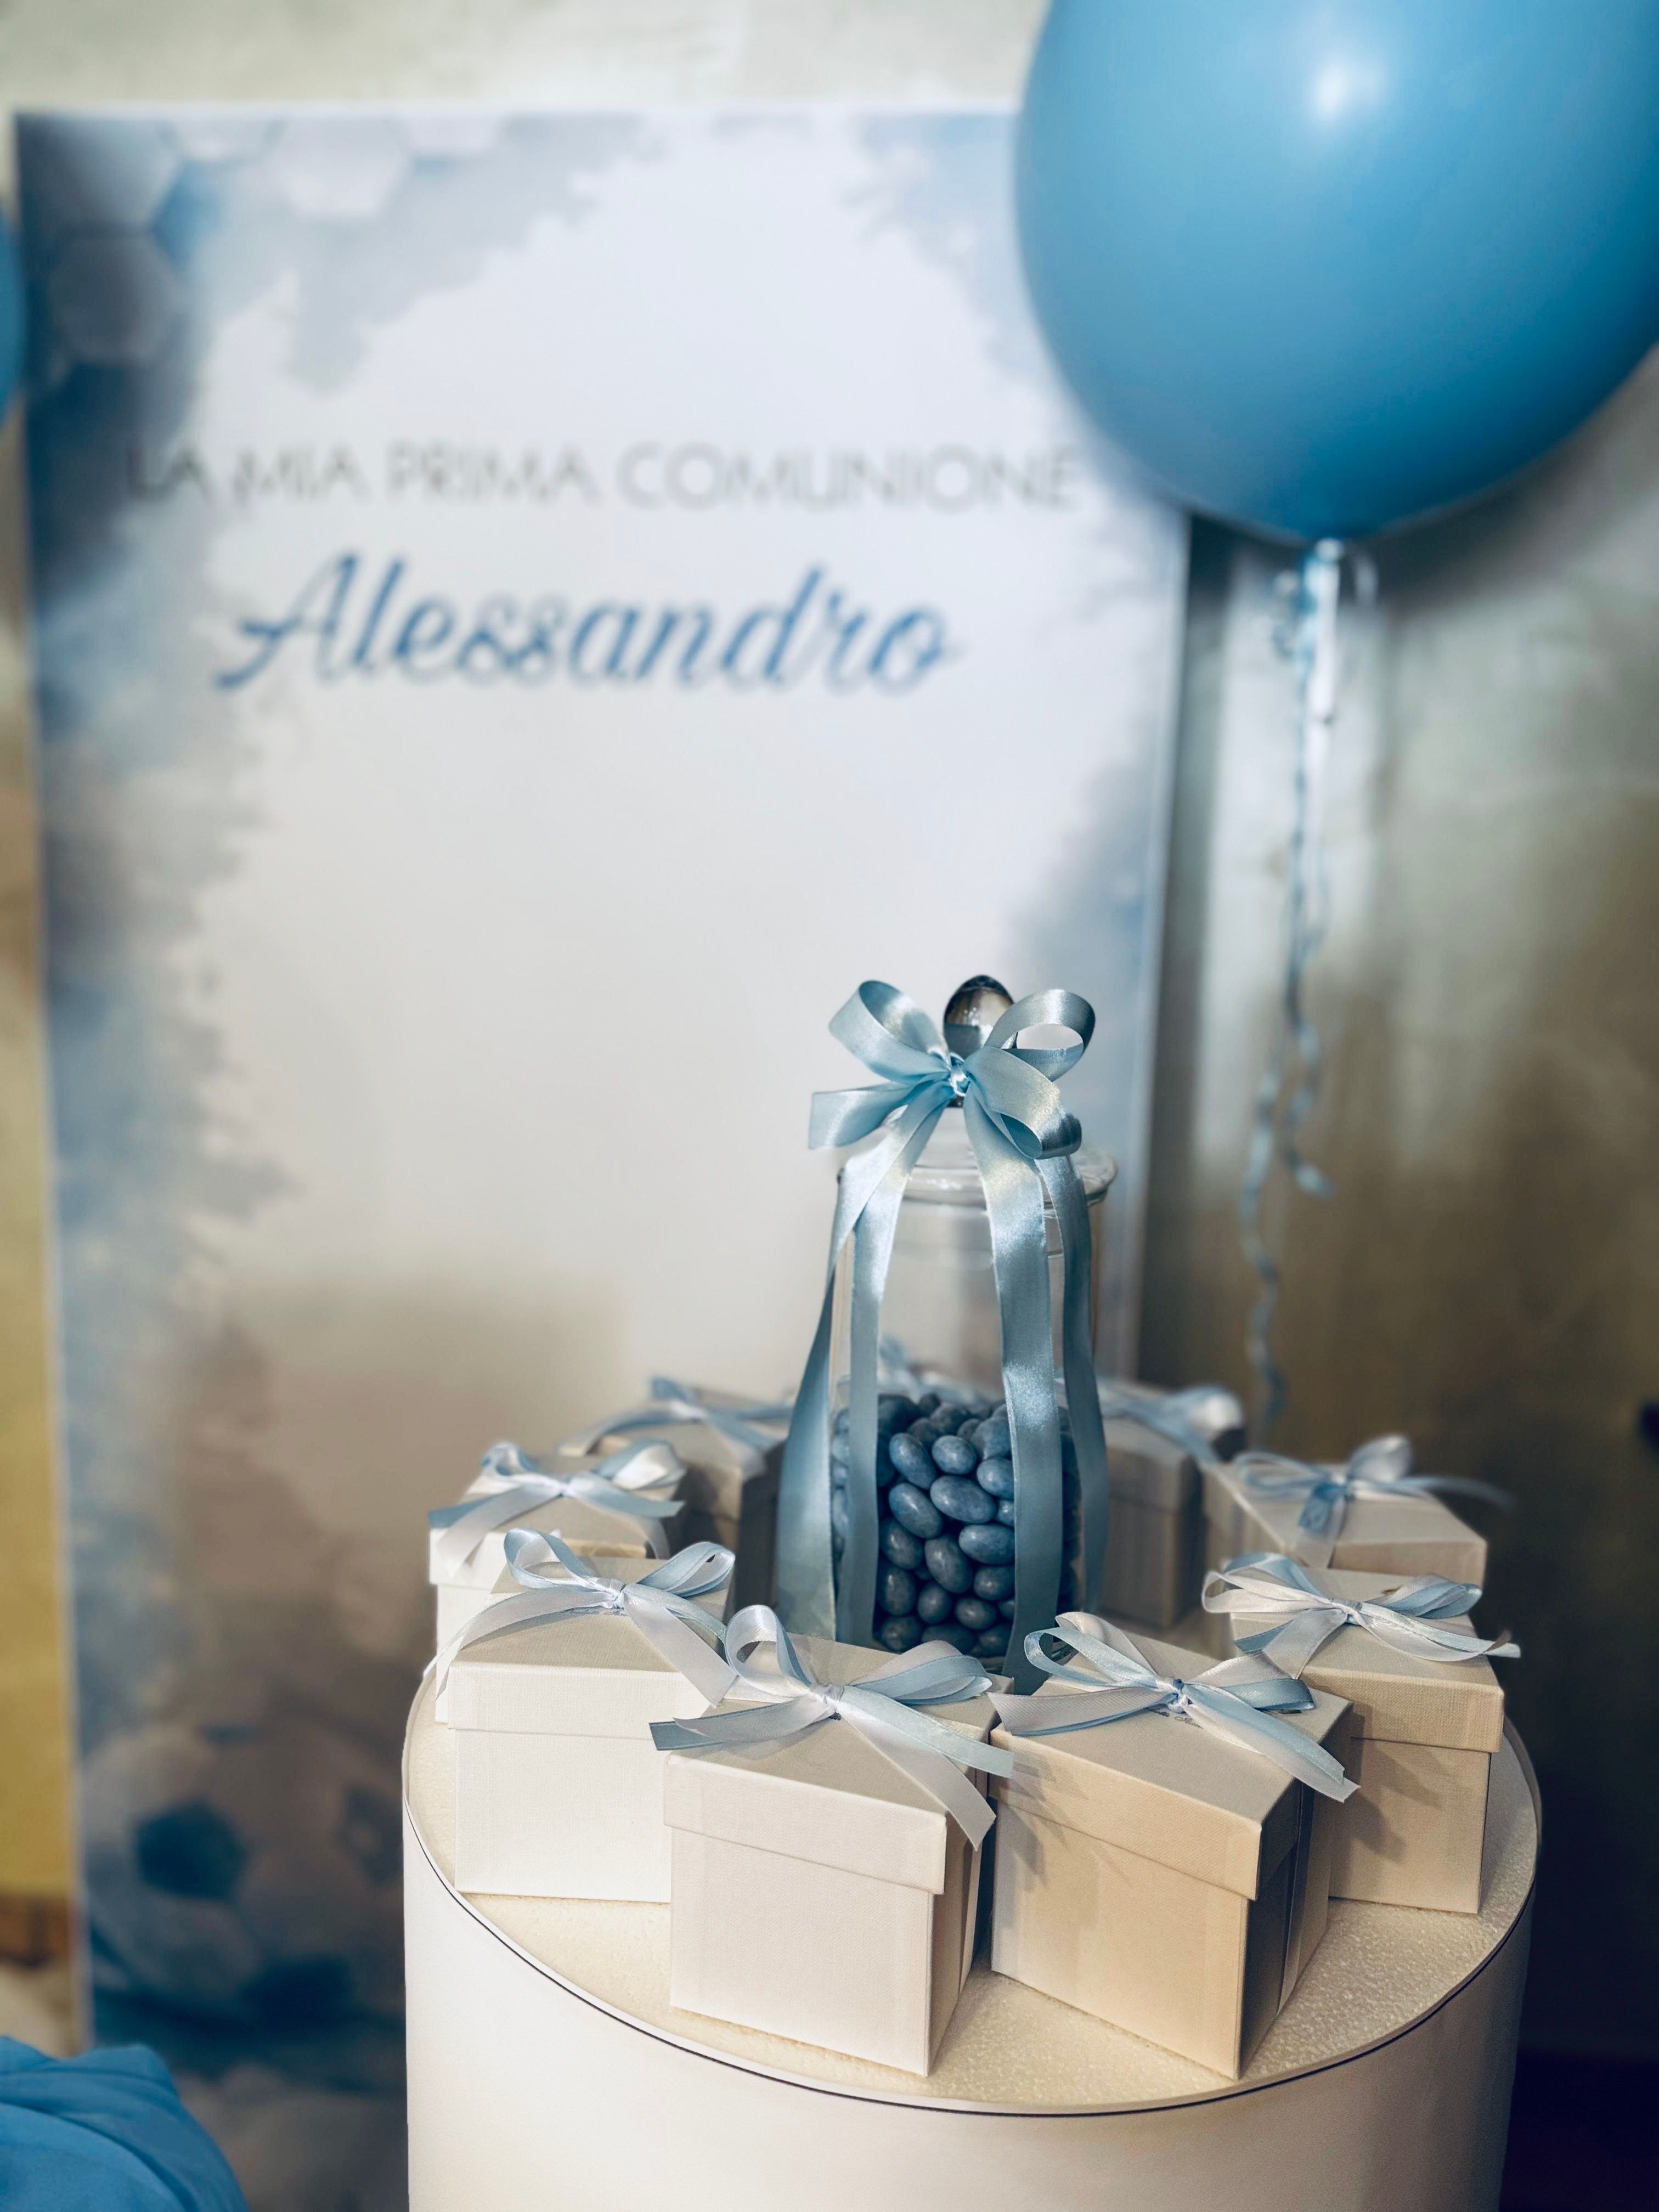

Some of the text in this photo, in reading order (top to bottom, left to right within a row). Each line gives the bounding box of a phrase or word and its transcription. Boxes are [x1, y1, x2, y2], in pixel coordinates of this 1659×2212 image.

[128, 442, 1077, 511] LA MIA PRIMA COMUNIONE
[215, 552, 955, 693] Alessandro
